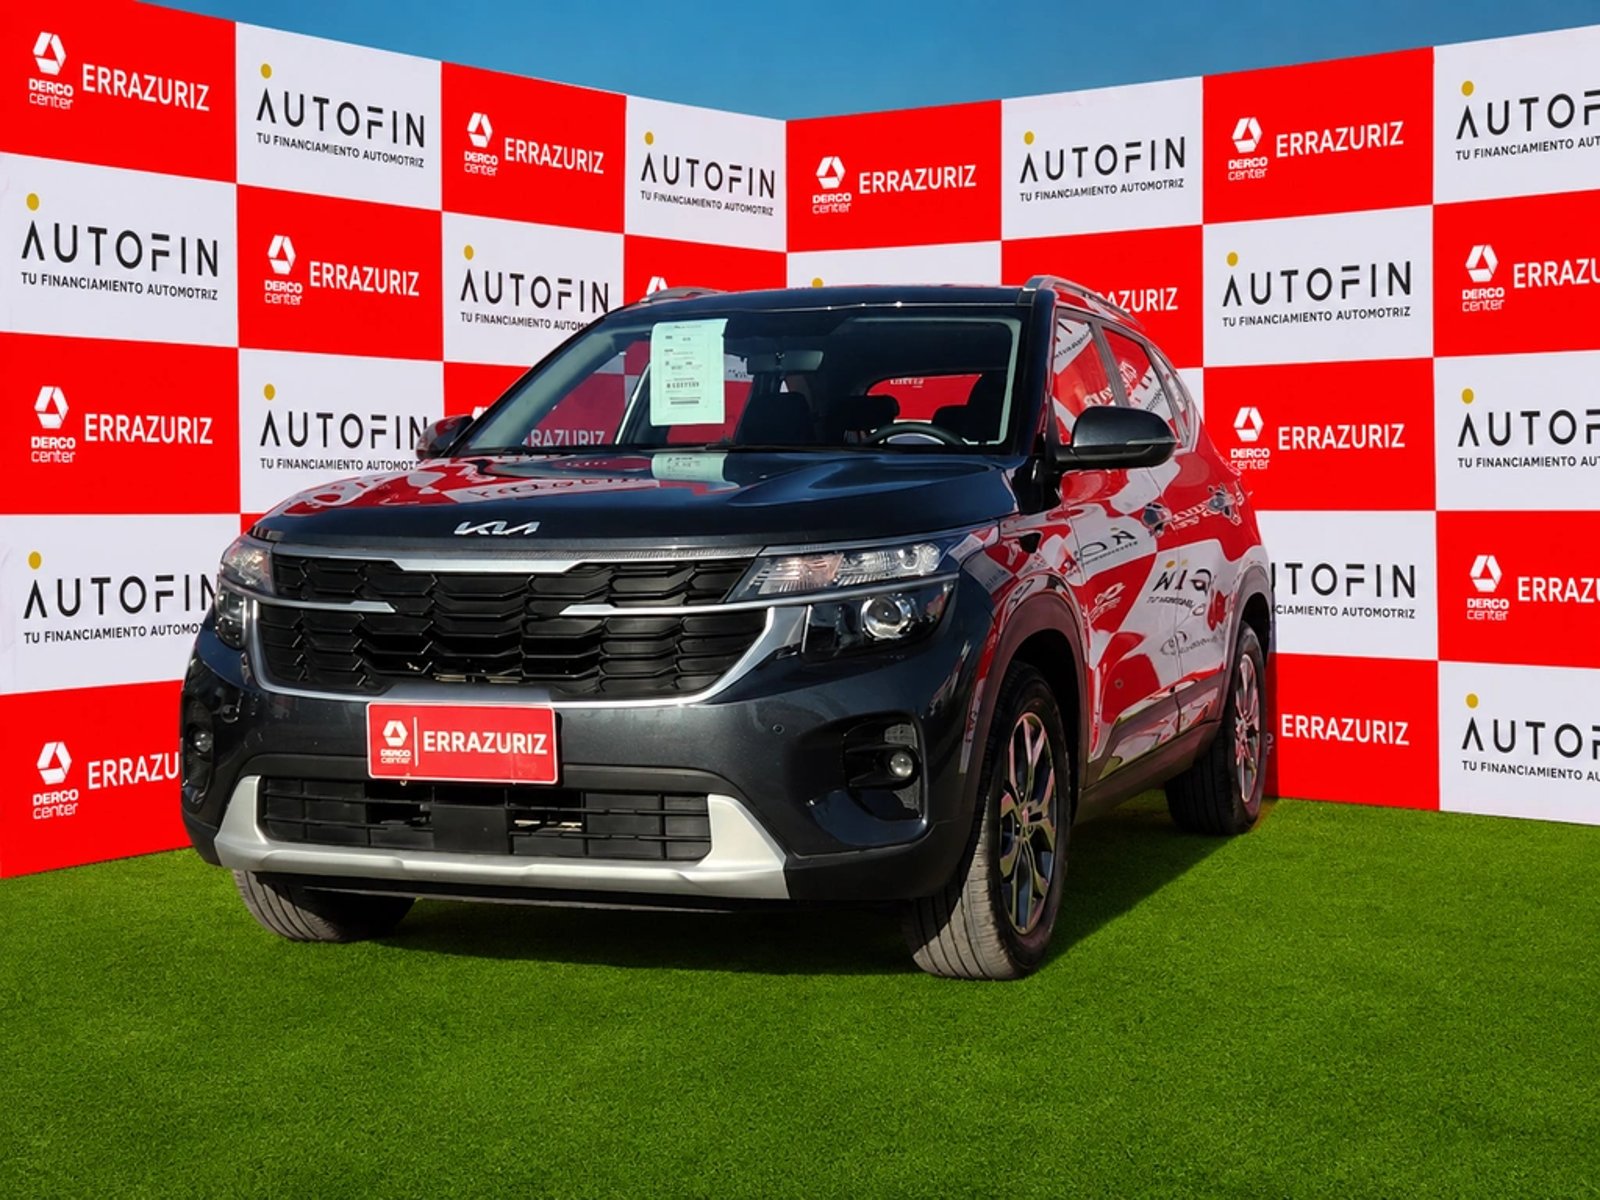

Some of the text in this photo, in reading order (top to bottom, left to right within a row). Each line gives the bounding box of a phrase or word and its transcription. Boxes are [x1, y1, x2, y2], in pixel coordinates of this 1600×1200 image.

[29, 79, 73, 97] DERCO
[83, 64, 209, 111] ERRAZURIZ
[30, 93, 72, 108] center
[257, 89, 424, 147] AUTOFIN
[1277, 121, 1403, 157] ERRAZURIZ
[256, 132, 423, 167] TU FINANCIAMIENTO AUTOMOTRIZ
[464, 151, 498, 165] DERCO
[505, 138, 603, 174] ERRAZURIZ
[1455, 149, 1471, 161] TU
[1475, 139, 1573, 158] FINANCIAMIENTO
[1020, 137, 1184, 183] AUTOFIN
[1227, 156, 1269, 170] DERCO
[641, 153, 774, 198] AUTOFIN
[860, 165, 976, 194] ERRAZURIZ
[1228, 168, 1268, 181] center
[812, 192, 852, 205] DERCO
[1020, 178, 1183, 202] TU FINANCIAMIENTO AUTOMOTRIZ
[640, 190, 774, 217] TU FINANCIAMIENTO AUTOMOTRIZ
[812, 202, 851, 214] center
[22, 221, 217, 277] AUTOFIN
[21, 271, 217, 300] TU FINANCIAMIENTO AUTOMOTRIZ
[265, 280, 302, 294] DERCO
[310, 261, 419, 296] ERRAZURIZ
[1223, 261, 1410, 307] AUTOFIN
[265, 292, 303, 306] center
[461, 269, 609, 313] AUTOFIN
[1462, 287, 1504, 301] DERCO
[1462, 299, 1505, 312] center
[460, 311, 473, 323] TU
[476, 314, 550, 328] FINANCIAMIENTO
[1222, 306, 1411, 327] TU FINANCIAMIENTO AUTOMOTRIZ
[85, 414, 212, 444] ERRAZURIZ
[1279, 424, 1405, 450] ERRAZURIZ
[30, 435, 76, 449] DERCO
[31, 449, 76, 464] center
[1230, 447, 1271, 458] DERCO
[1458, 457, 1473, 468] TU
[1476, 455, 1577, 468] FINANCIAMIENTO
[260, 457, 274, 469] TU
[277, 458, 364, 471] FINANCIAMIENTO
[1341, 607, 1415, 619] AUTOMOTRIZ
[1466, 597, 1510, 611] DERCO
[1467, 609, 1508, 621] center
[23, 632, 40, 644] TU
[45, 626, 146, 642] FINANCIAMIENTO
[1282, 714, 1409, 745] ERRAZURIZ
[423, 731, 548, 755] ERRAZURIZ
[88, 752, 179, 789] ERRAZU
[1461, 760, 1477, 771] TU
[1481, 762, 1582, 780] FINANCIAMIENTO
[33, 789, 78, 806] DERCO
[34, 803, 78, 819] center
